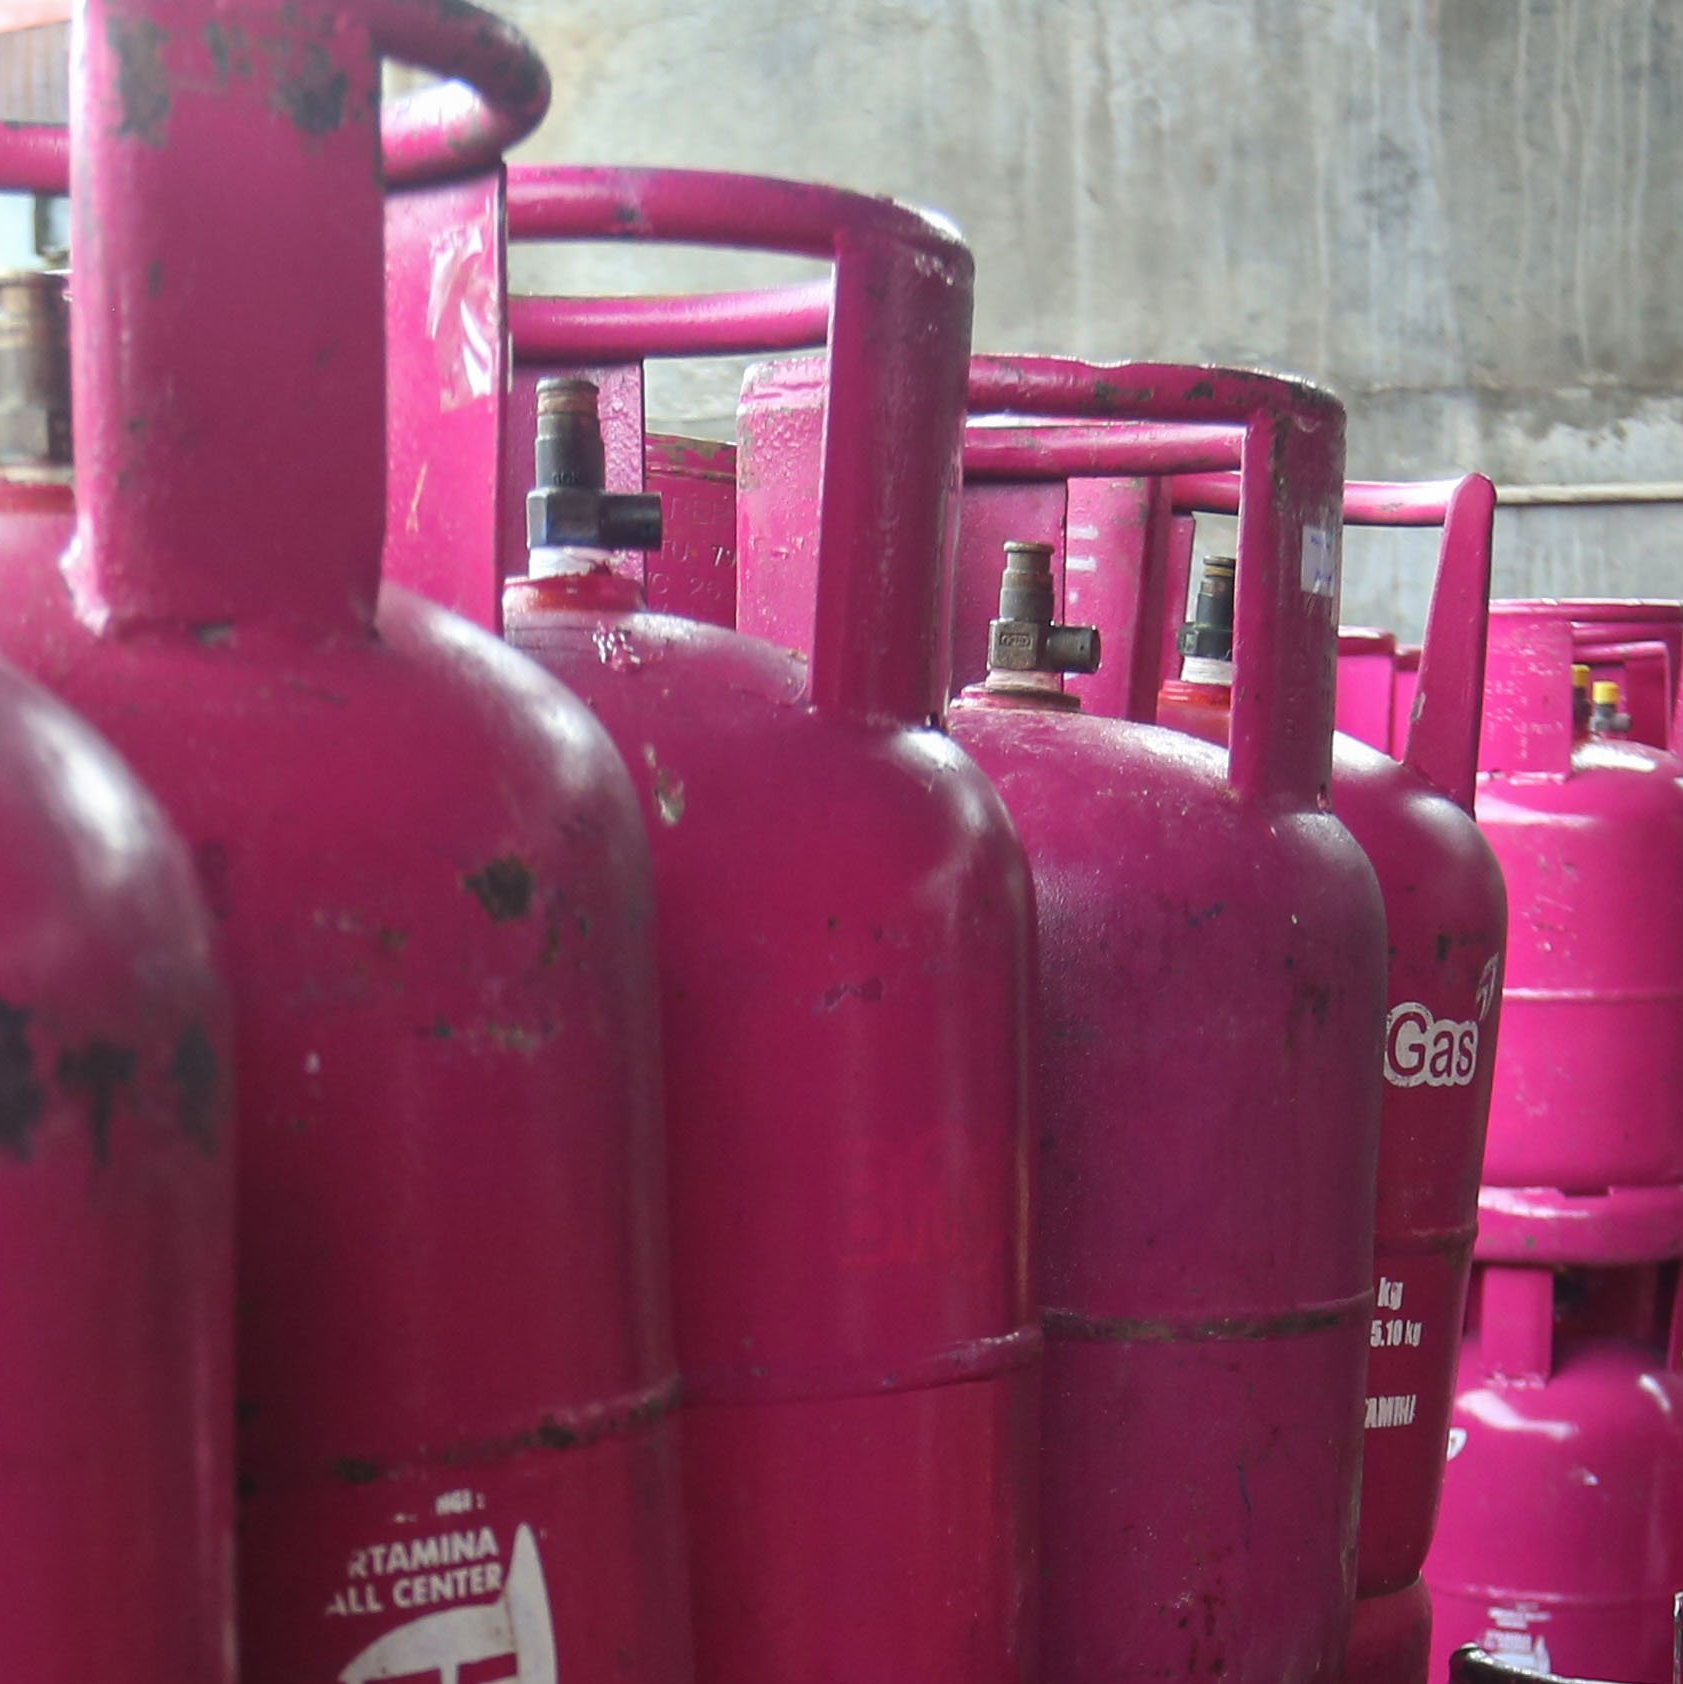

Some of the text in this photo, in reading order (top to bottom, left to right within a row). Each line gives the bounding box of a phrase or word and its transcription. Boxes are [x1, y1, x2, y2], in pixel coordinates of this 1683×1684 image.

[1383, 1001, 1479, 1088] Gas
[346, 1526, 502, 1579] RTAMINA
[324, 1560, 505, 1617] ALL CENTER
